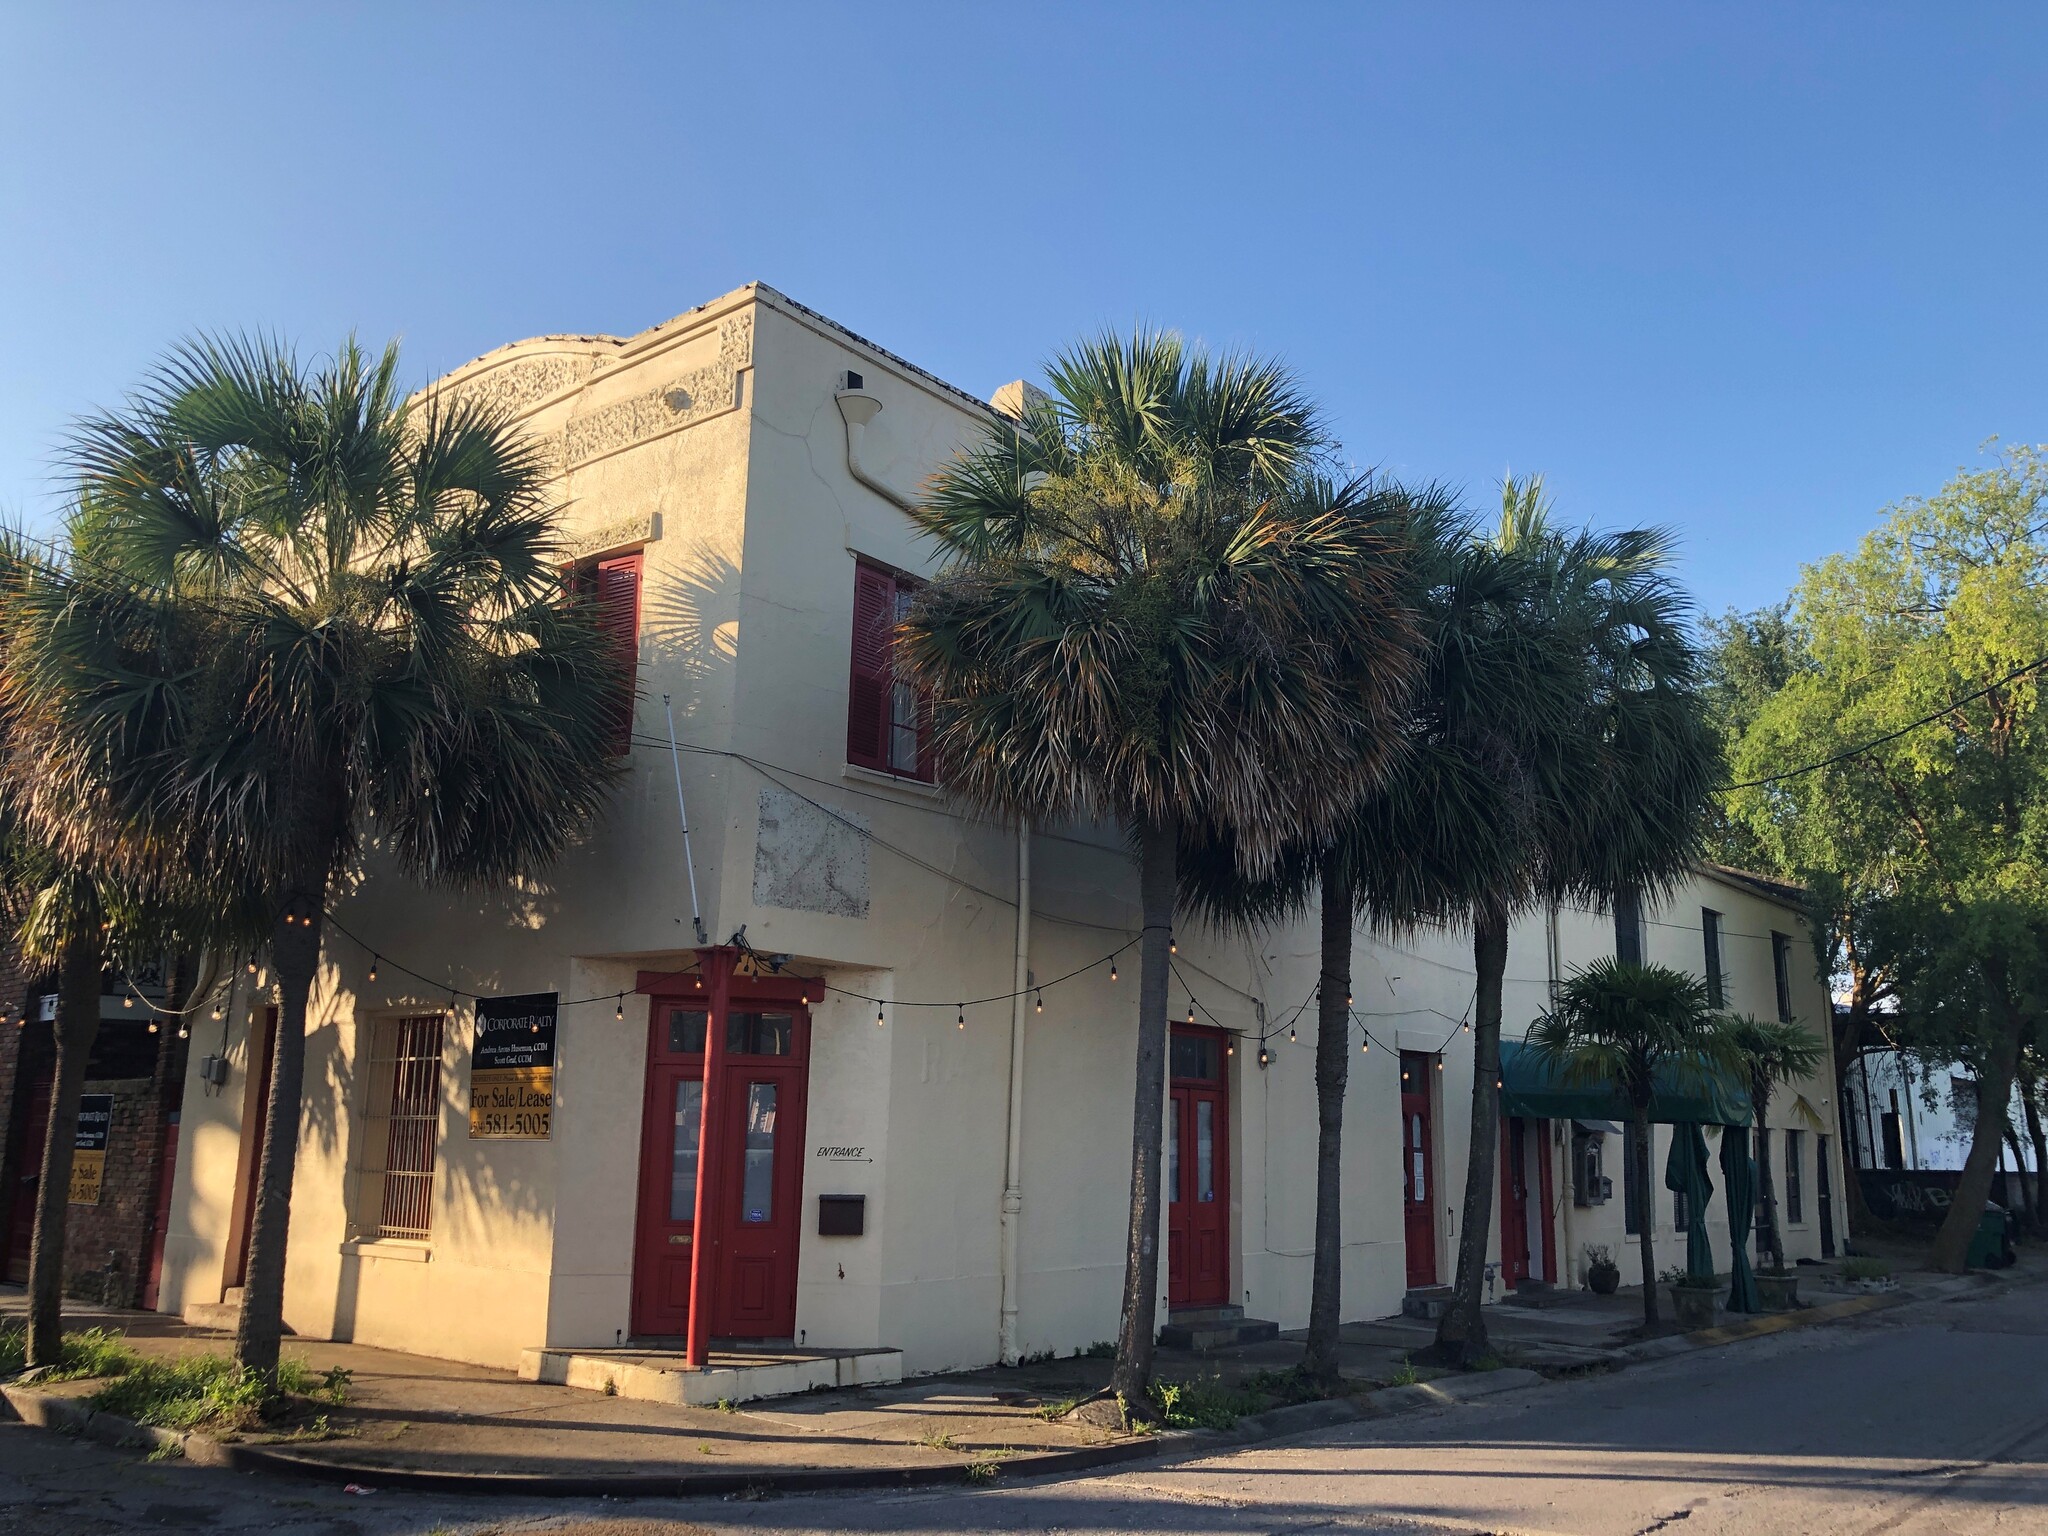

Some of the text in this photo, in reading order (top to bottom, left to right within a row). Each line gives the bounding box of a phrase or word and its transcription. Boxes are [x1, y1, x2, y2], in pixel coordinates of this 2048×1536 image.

[487, 1014, 555, 1032] CORPORATE RALTY
[471, 1086, 552, 1109] For Sale/Lease
[485, 1113, 549, 1135] 581-5005
[816, 1146, 865, 1157] ENTRANCE
[79, 1163, 97, 1180] Sale
